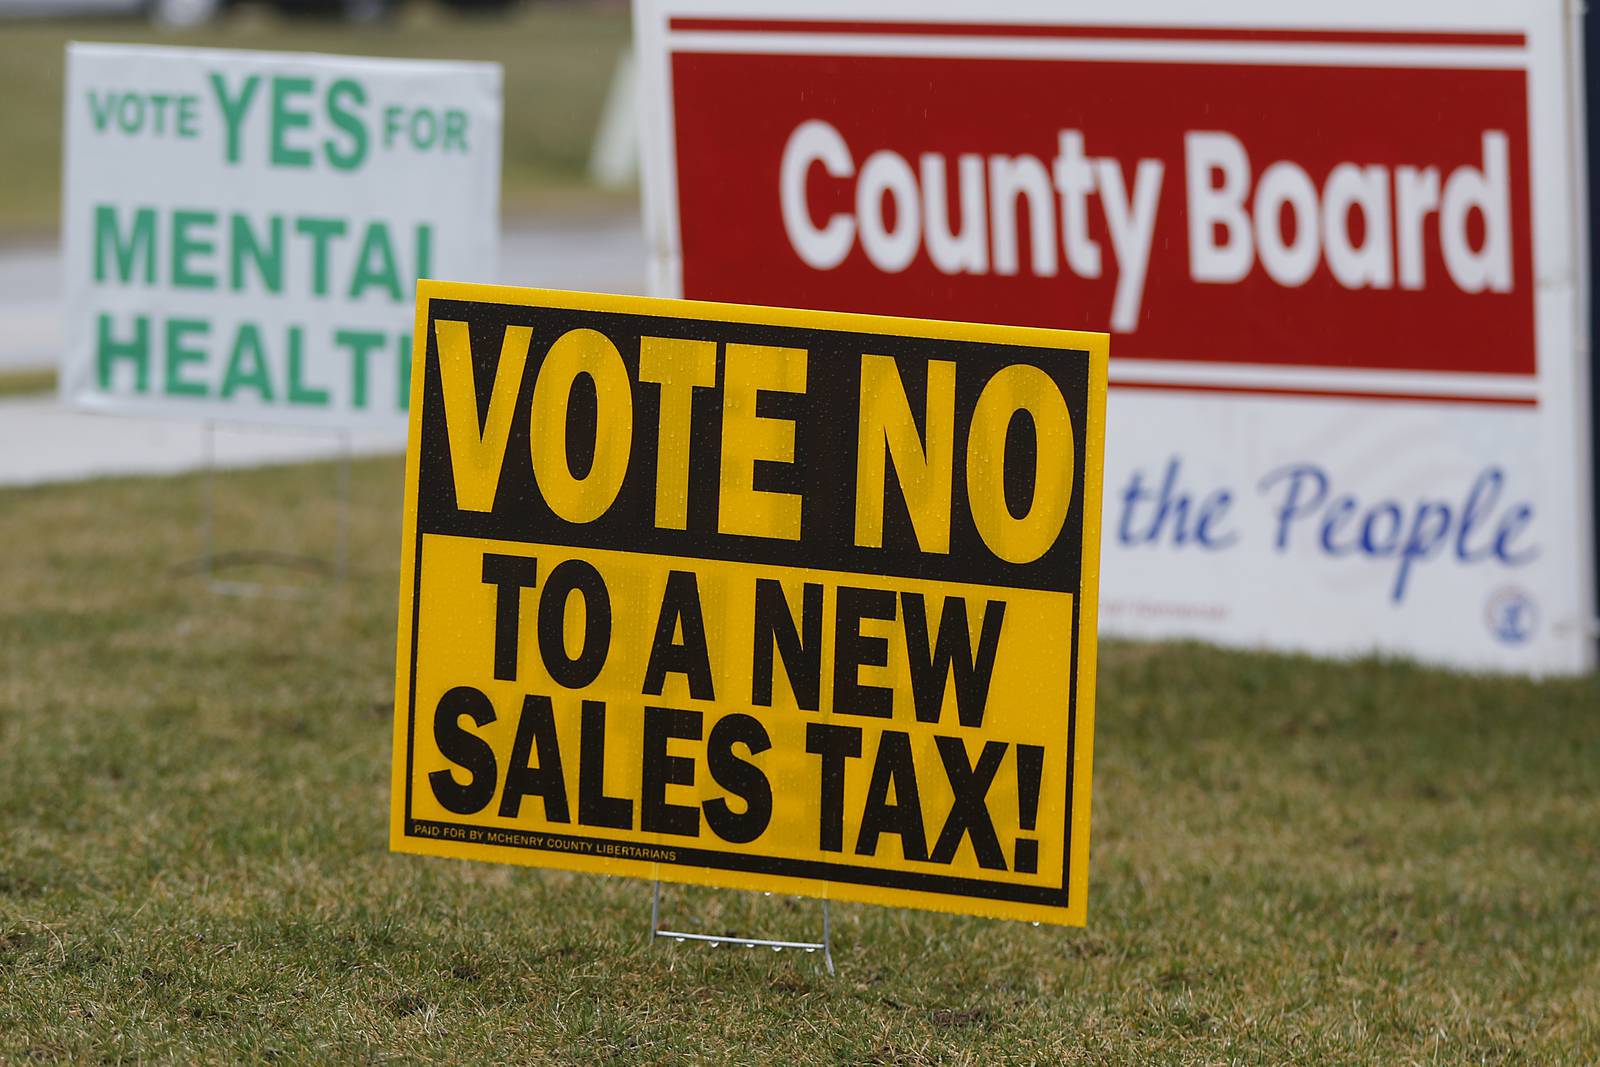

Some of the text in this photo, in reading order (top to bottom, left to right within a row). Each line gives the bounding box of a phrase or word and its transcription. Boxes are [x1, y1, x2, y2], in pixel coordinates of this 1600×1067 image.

[87, 72, 470, 171] VOTE YES FOR
[780, 119, 1513, 333] County Board
[95, 312, 414, 412] HEALT
[434, 318, 1074, 564] VOTE NO
[1117, 454, 1538, 604] the People
[482, 553, 1007, 728] TO A NEW
[414, 824, 678, 862] PAID FOR BY MCHENRY COUNTY LIBERTARIANS
[428, 685, 1045, 874] SALES TAX!
